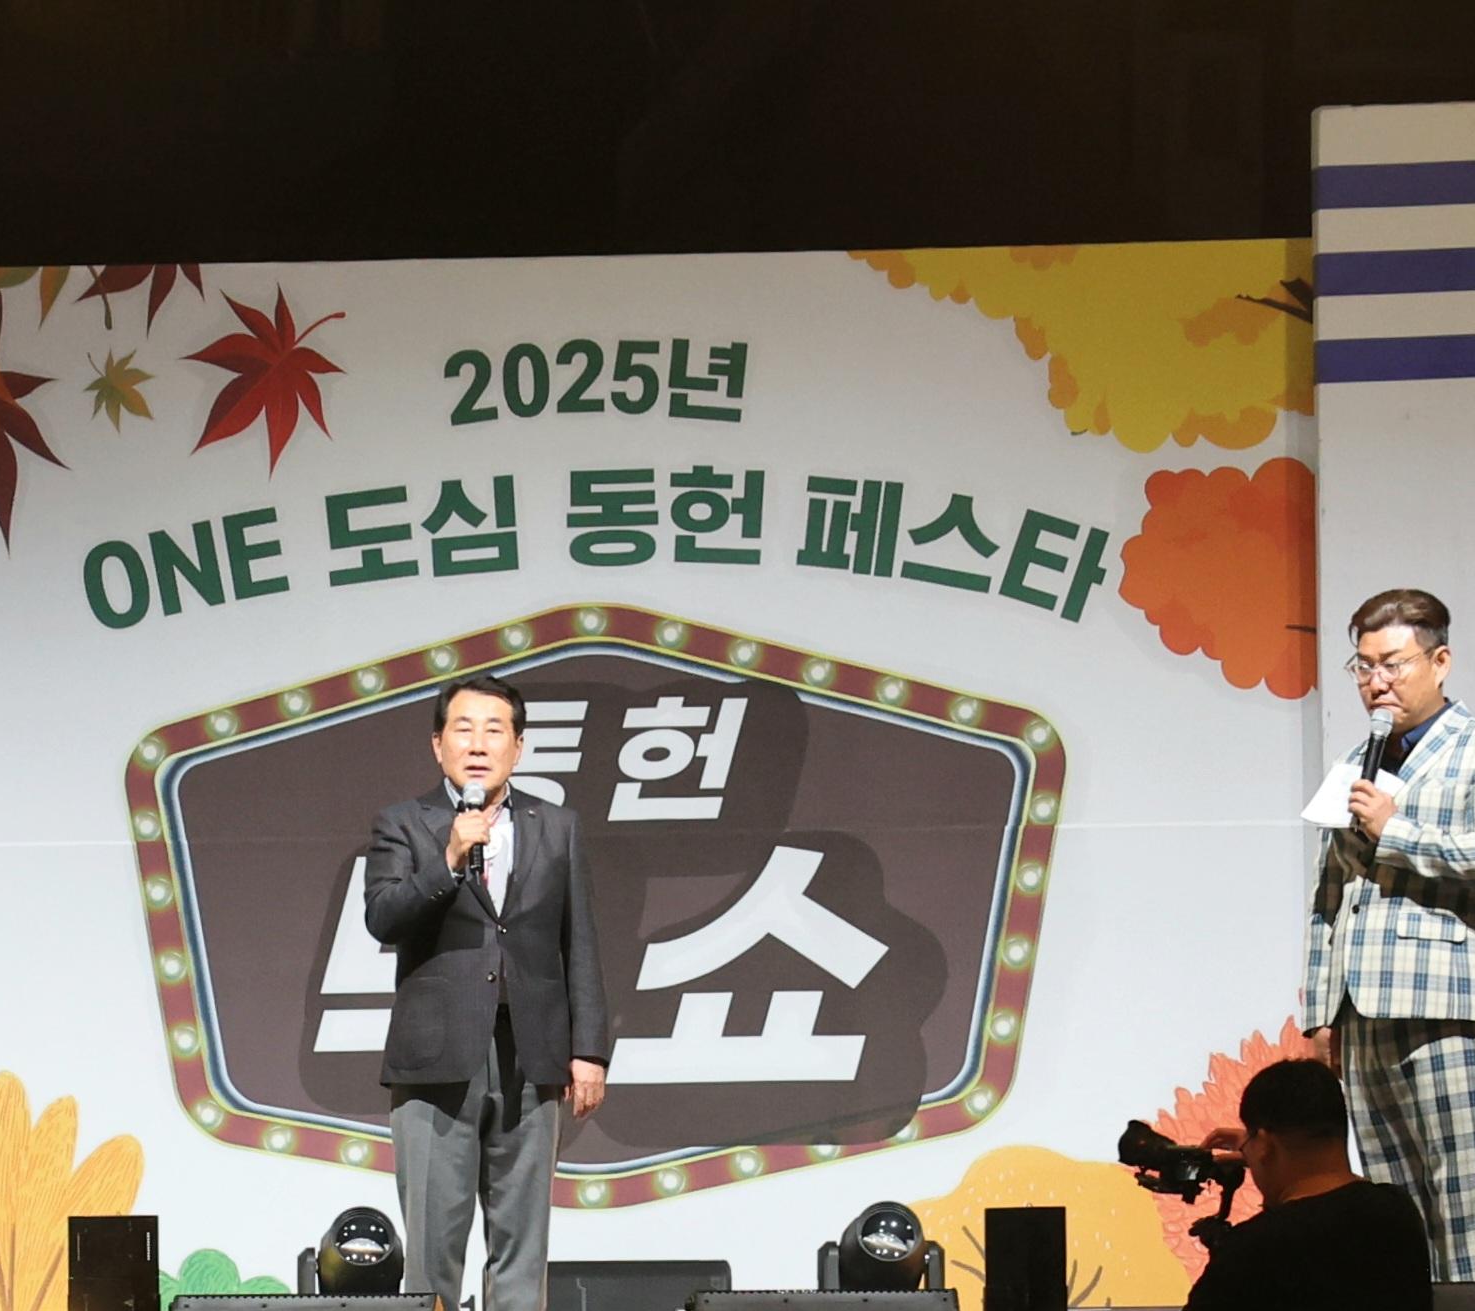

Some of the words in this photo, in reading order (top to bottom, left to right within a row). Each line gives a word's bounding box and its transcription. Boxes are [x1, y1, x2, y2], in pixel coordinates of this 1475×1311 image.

[443, 337, 749, 427] 2025년
[83, 506, 290, 630] ONE
[324, 474, 520, 588] 도심
[566, 465, 765, 567] 동헌
[795, 475, 1111, 624] 페스타
